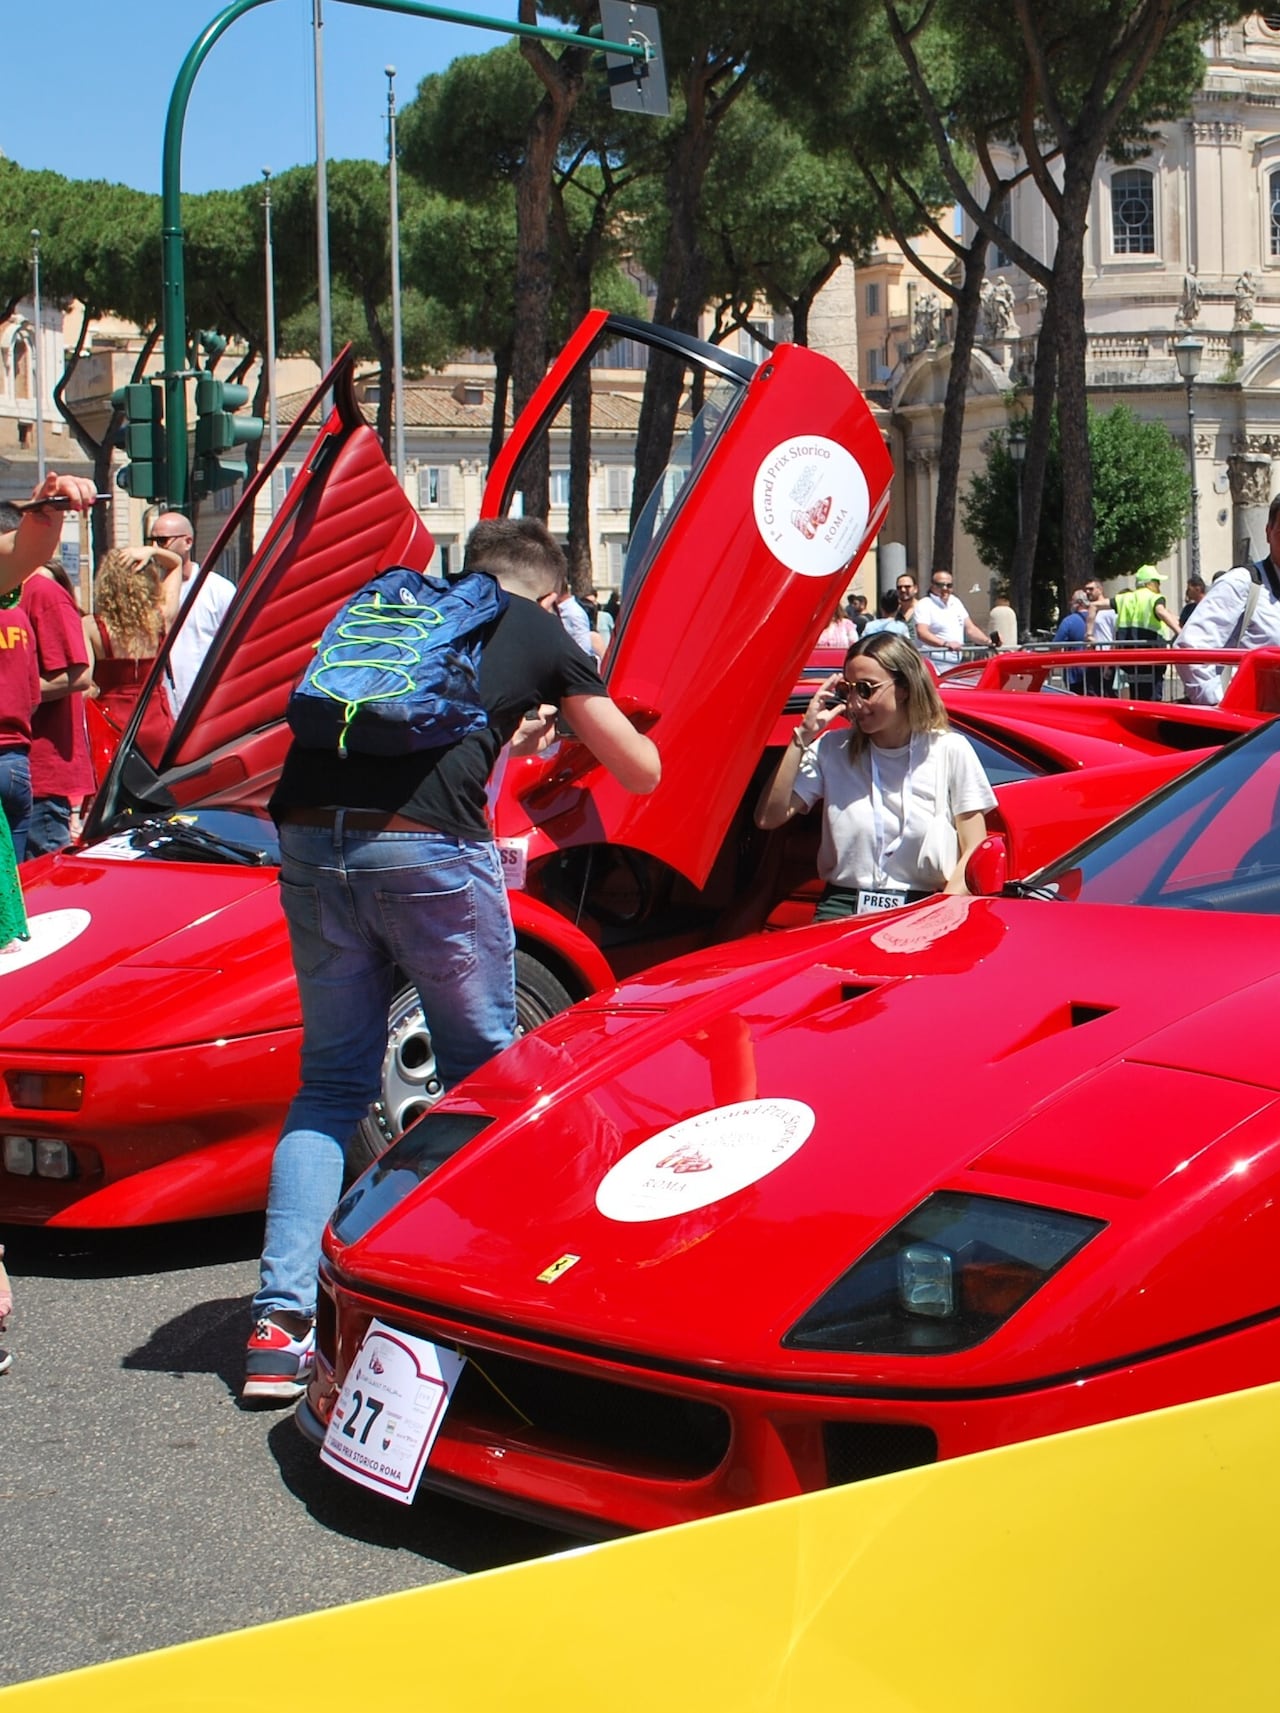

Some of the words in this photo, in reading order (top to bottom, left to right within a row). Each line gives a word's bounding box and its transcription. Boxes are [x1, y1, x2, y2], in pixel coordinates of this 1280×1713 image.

[788, 444, 831, 459] Storico
[767, 454, 790, 479] Prix
[763, 478, 775, 525] Grand
[824, 508, 849, 544] ROMA
[863, 894, 899, 909] PRESS
[641, 1178, 688, 1193] ROMA
[342, 1389, 385, 1445] 27
[352, 1451, 380, 1472] STORICO
[379, 1463, 401, 1480] ROMA
